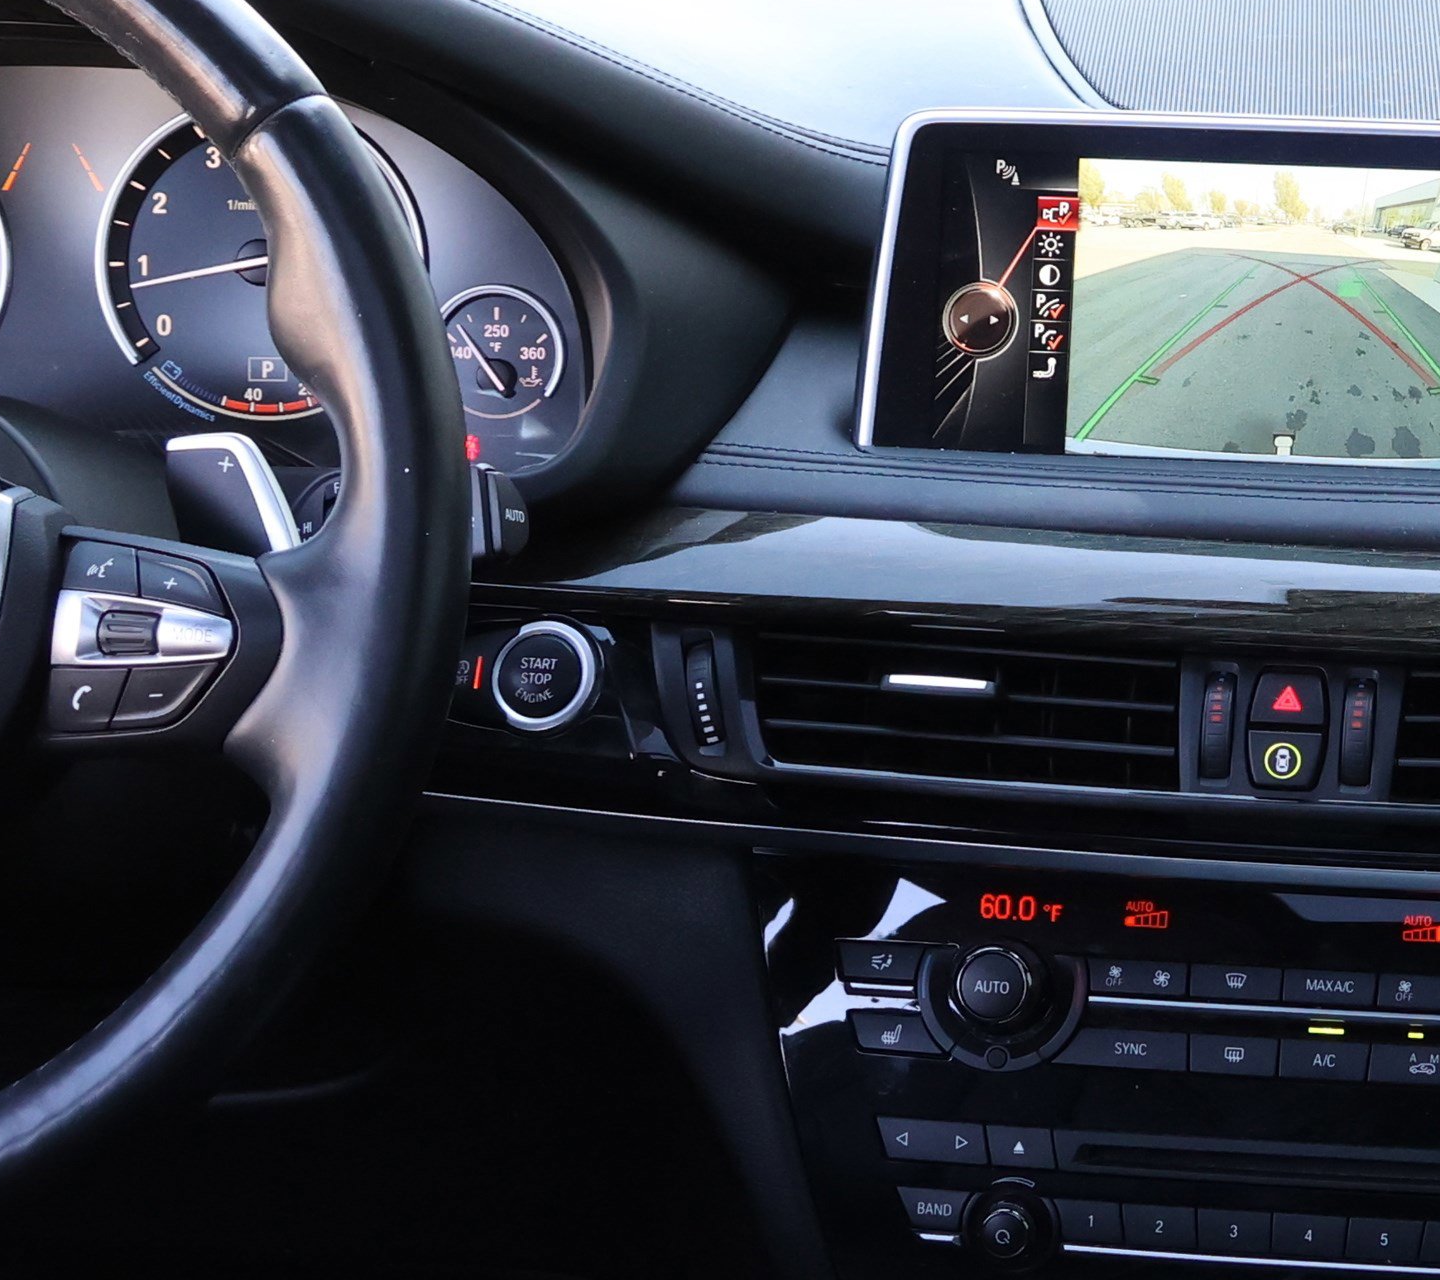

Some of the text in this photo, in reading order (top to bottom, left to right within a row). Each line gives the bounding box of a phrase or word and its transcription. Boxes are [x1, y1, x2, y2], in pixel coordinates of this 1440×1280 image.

[205, 146, 221, 169] 3
[152, 191, 168, 214] 2
[137, 253, 149, 277] 1
[156, 313, 172, 337] 0
[484, 323, 509, 338] 250
[519, 346, 546, 361] 360
[261, 359, 275, 378] P
[143, 370, 216, 423] EfficientDynamics
[243, 387, 263, 402] 40
[504, 508, 526, 523] AUTO
[520, 657, 558, 670] START
[520, 672, 552, 685] STOP
[514, 687, 555, 704] ENGINE
[980, 893, 1036, 922] 60.0
[1125, 900, 1155, 914] AUTO
[1403, 915, 1433, 926] AUTO
[973, 978, 1010, 995] AUTO
[1105, 975, 1124, 988] OFF
[1395, 991, 1414, 1003] OFF
[1114, 1041, 1148, 1057] SYNC
[1313, 1053, 1337, 1069] A/C
[917, 1201, 952, 1218] BAND
[1088, 1214, 1095, 1228] 1
[1155, 1220, 1164, 1234] 2
[1229, 1224, 1238, 1238] 3
[1304, 1229, 1313, 1242] 4
[1380, 1233, 1389, 1246] 5
